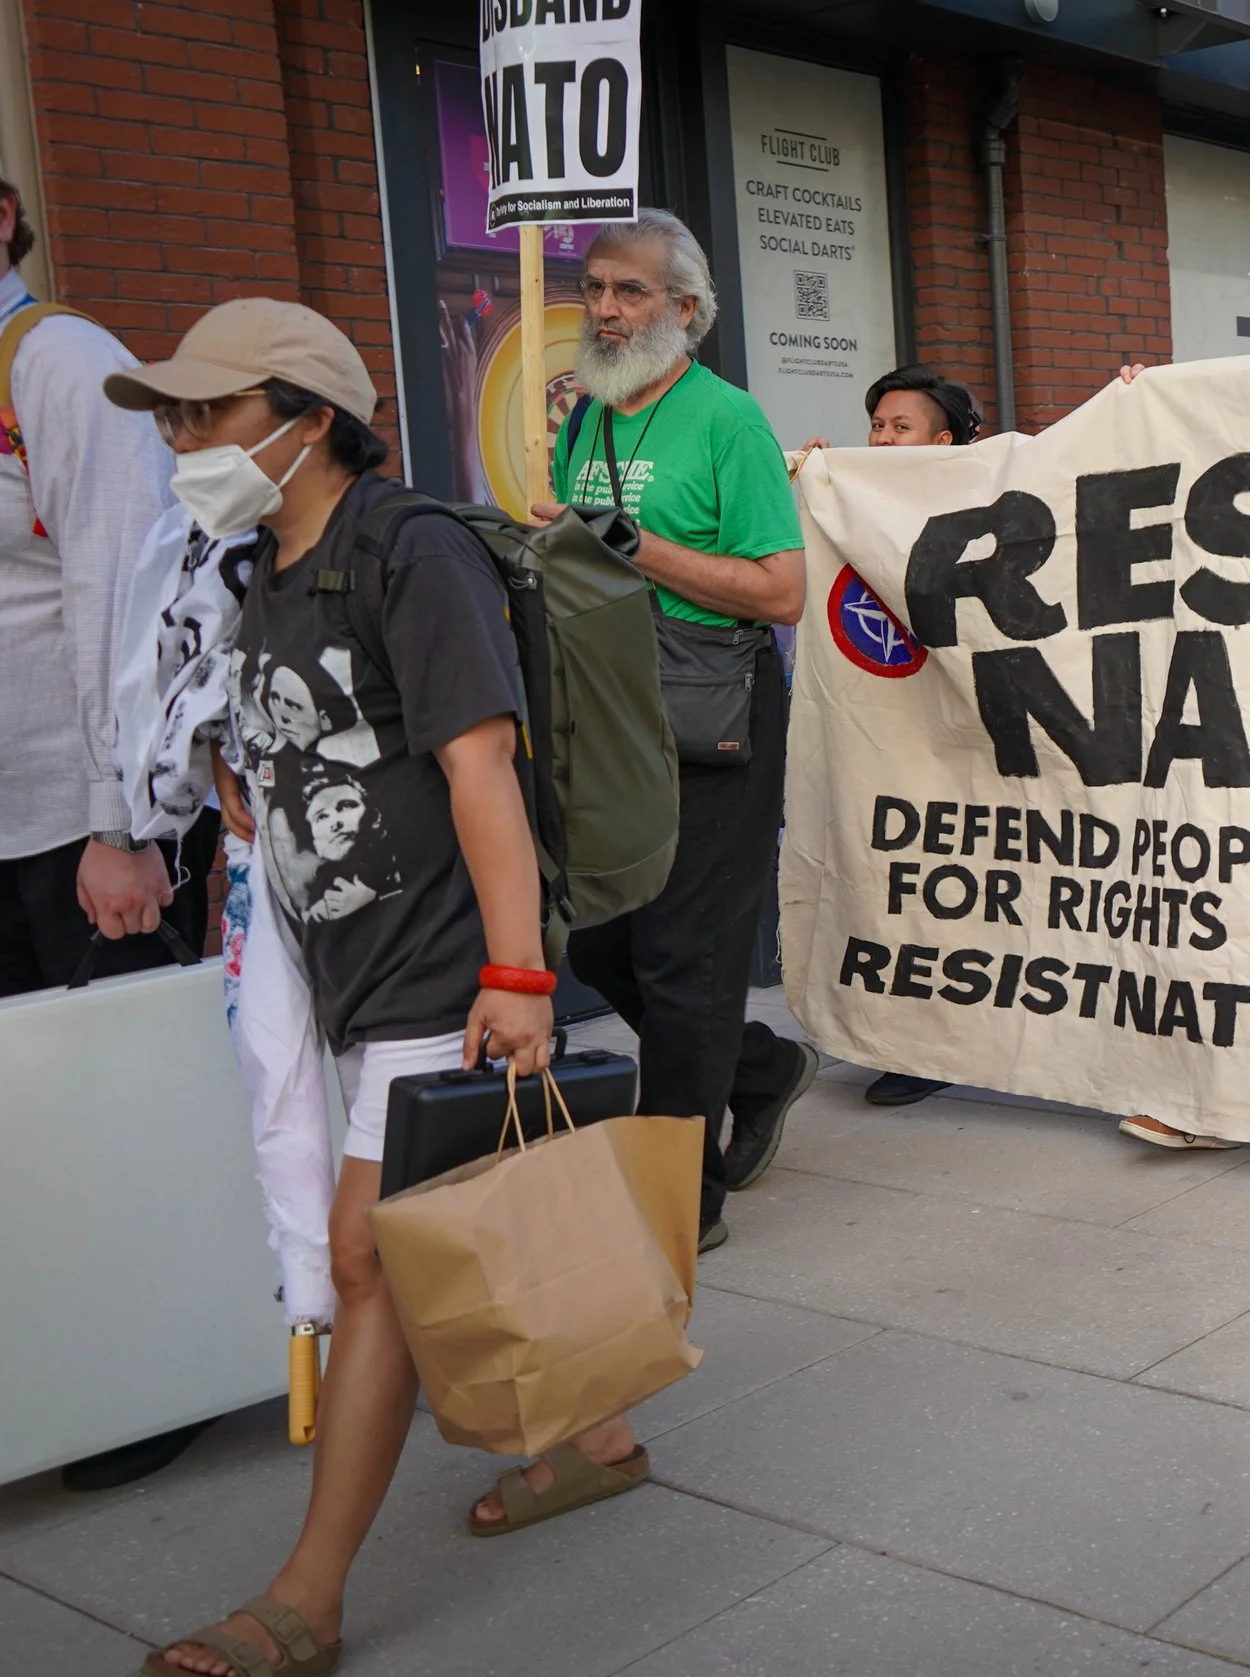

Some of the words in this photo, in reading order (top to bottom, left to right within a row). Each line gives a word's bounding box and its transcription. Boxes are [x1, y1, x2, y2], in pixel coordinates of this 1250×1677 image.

[484, 57, 629, 190] NATO
[760, 134, 805, 161] FLIGHT
[810, 143, 840, 166] CLUB
[508, 201, 516, 212] for
[517, 199, 561, 212] Socialism
[563, 198, 579, 209] and
[581, 196, 630, 209] Liberation
[746, 179, 789, 201] CRAFT
[792, 187, 862, 212] COCKTAILS
[757, 207, 822, 231] ELEVATED
[826, 217, 854, 235] EATS
[759, 234, 809, 256] SOCIAL
[769, 331, 821, 350] COMING
[823, 336, 857, 352] SOON
[871, 795, 1120, 870] DEFEND
[887, 861, 1023, 927] FOR
[1047, 875, 1227, 951] RIGHTS
